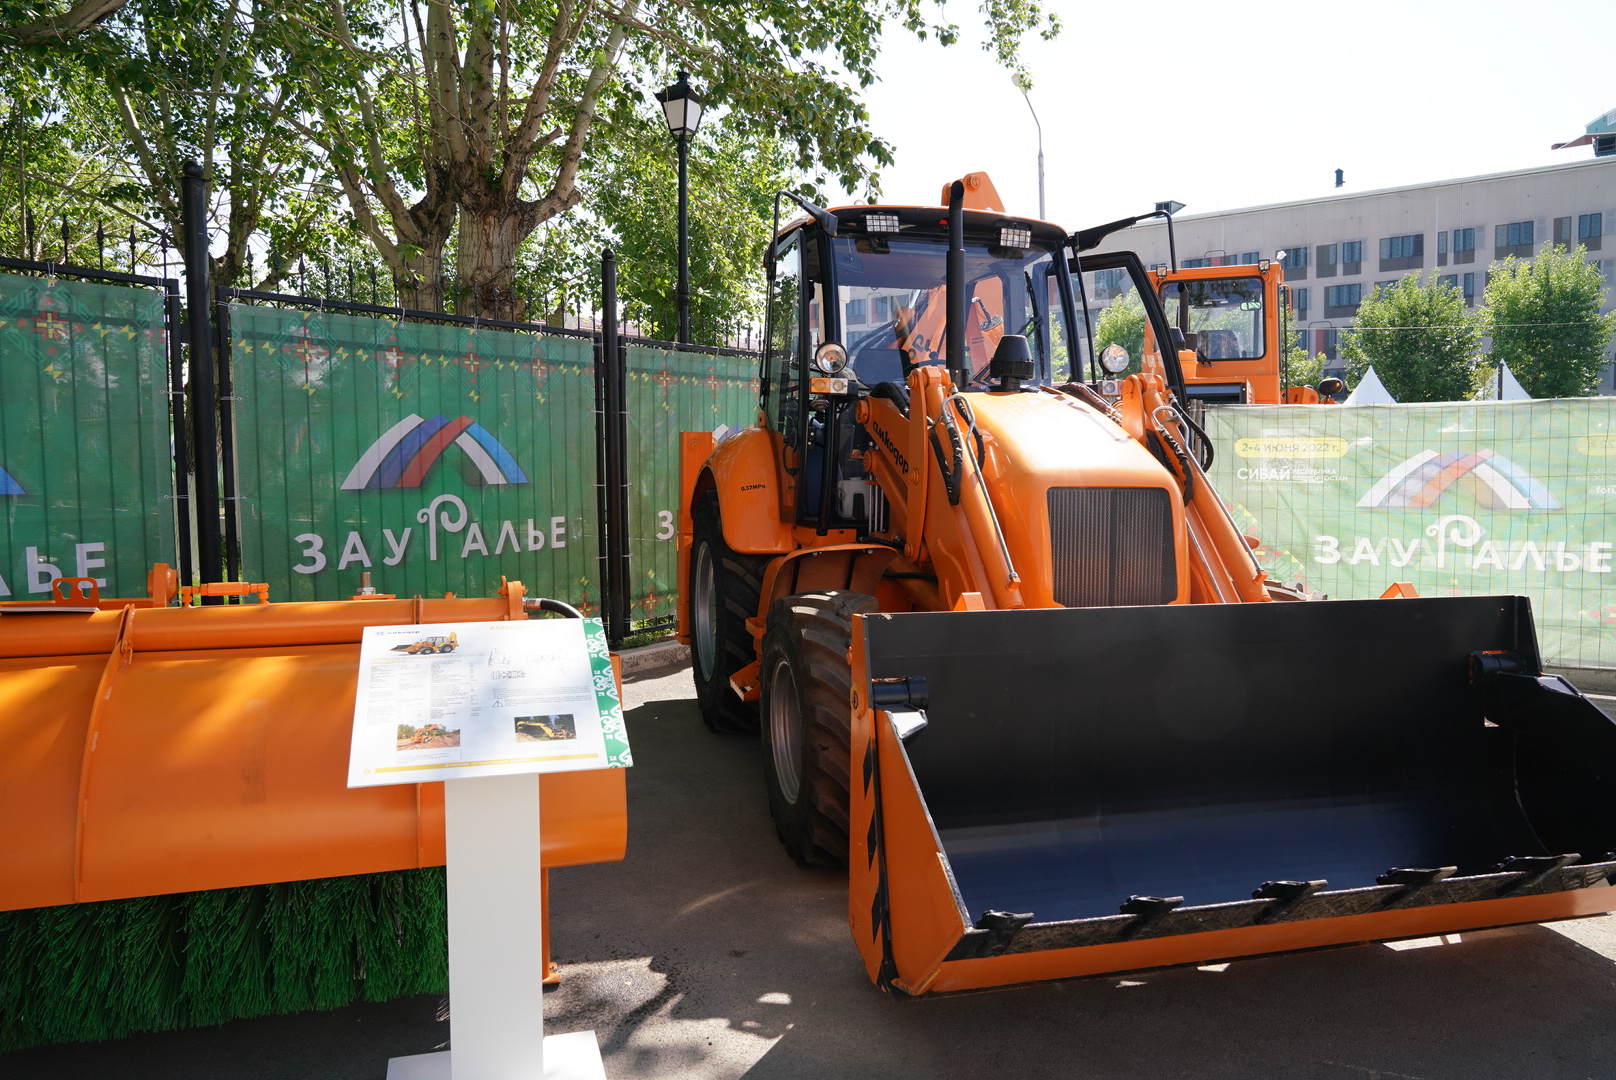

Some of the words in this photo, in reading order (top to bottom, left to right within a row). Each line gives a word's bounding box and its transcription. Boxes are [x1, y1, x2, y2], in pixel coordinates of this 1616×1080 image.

[1302, 442, 1329, 452] 2022
[1237, 465, 1291, 480] СИБАЙ
[292, 493, 566, 574] ЗАУРАЛЬЕ
[1314, 514, 1613, 573] ЗАУРАЛЬЕ
